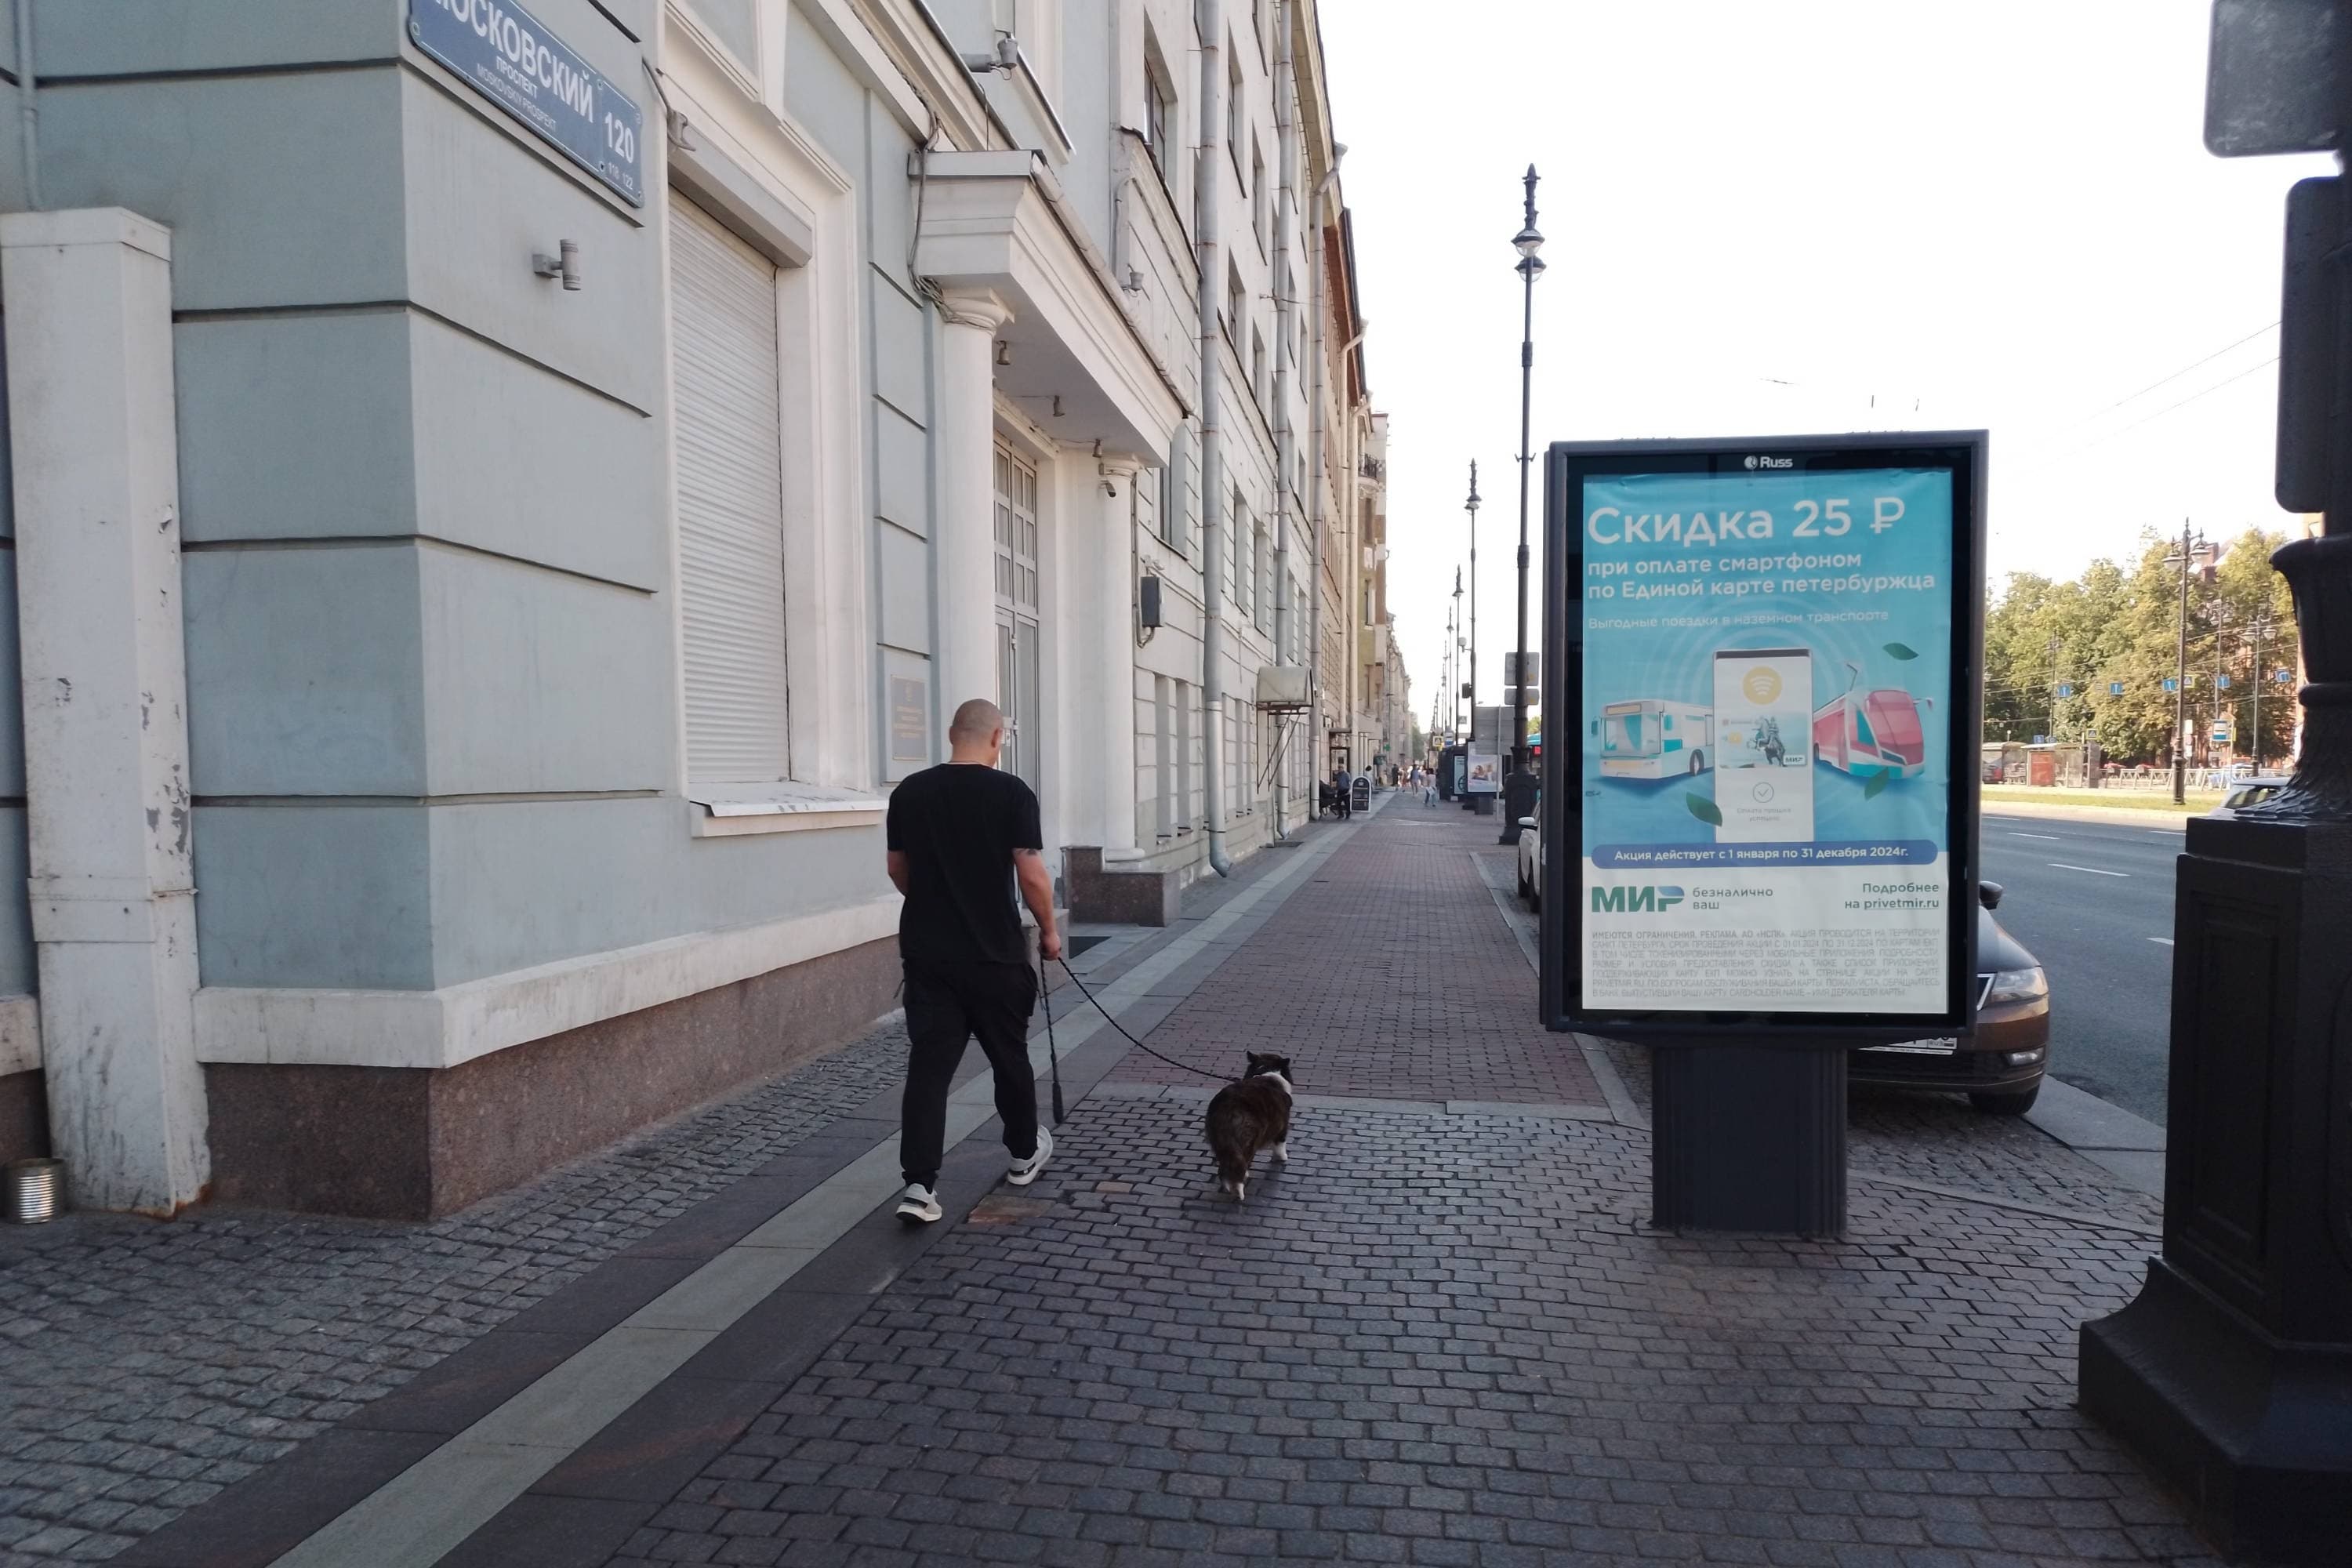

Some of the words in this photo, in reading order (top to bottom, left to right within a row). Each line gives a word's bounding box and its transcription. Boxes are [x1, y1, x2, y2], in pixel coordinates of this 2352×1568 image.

[435, 0, 593, 124] СКОВСКИЙ
[495, 56, 538, 100] ПРОСПЕКТ
[604, 111, 634, 164] 120
[1759, 456, 1794, 469] Russ
[1588, 506, 1774, 548] Скидка
[1792, 499, 1852, 537] 25
[1588, 561, 1628, 579] при
[1635, 558, 1712, 575] оплате
[1719, 552, 1862, 574] смартфоном
[1588, 585, 1615, 599] по
[1621, 579, 1704, 601] Единой
[1711, 579, 1776, 598] карте
[1781, 573, 1936, 594] петербуржца
[1588, 617, 1657, 630] Выгодные
[1661, 615, 1719, 627] поездки
[1733, 612, 1803, 625] наземном
[1806, 610, 1889, 624] транспорте
[1613, 850, 1652, 862] Акция
[1654, 849, 1715, 861] действует
[1718, 851, 1726, 860] с
[1728, 849, 1733, 859] 1
[1736, 850, 1780, 861] января
[1782, 849, 1798, 858] по
[1800, 848, 1813, 858] 31
[1816, 847, 1867, 859] декабря
[1869, 846, 1909, 858] 2024г.
[1591, 885, 1686, 913] МИР
[1692, 887, 1773, 898] безналично
[1862, 882, 1940, 895] Подробнее
[1692, 900, 1720, 910] ваш
[1844, 900, 1861, 909] на
[1864, 898, 1940, 911] privetmir.ru
